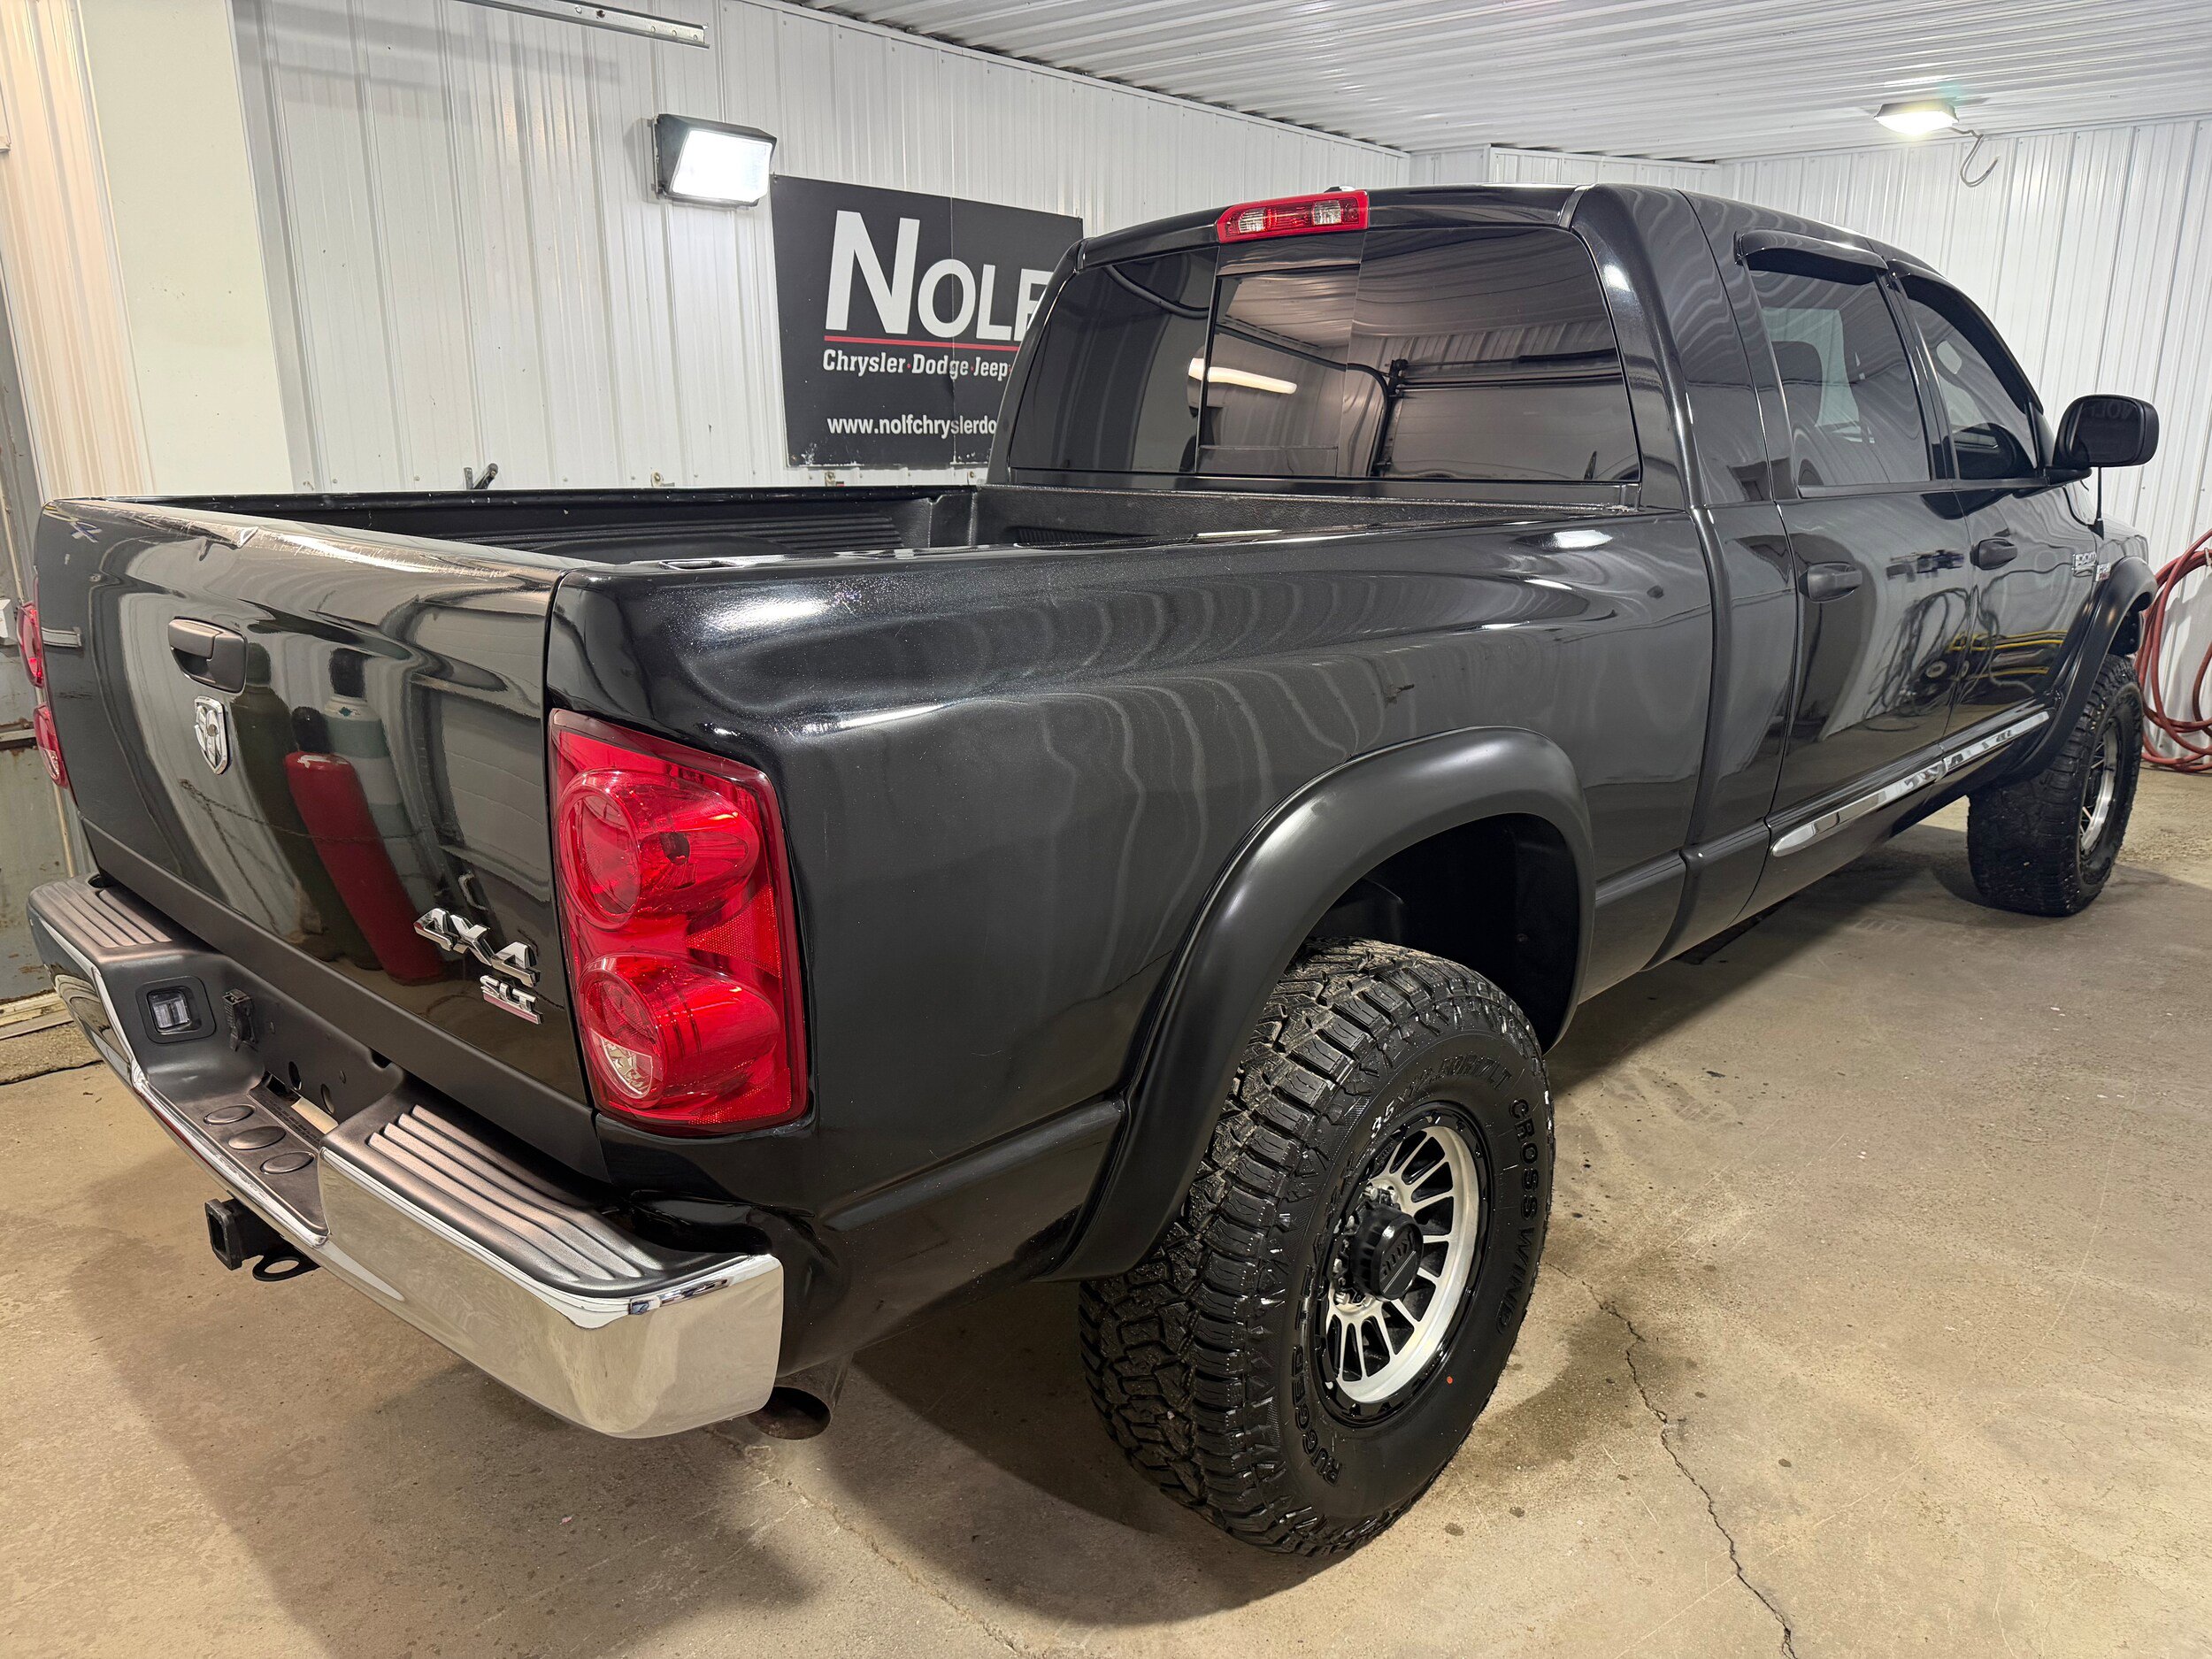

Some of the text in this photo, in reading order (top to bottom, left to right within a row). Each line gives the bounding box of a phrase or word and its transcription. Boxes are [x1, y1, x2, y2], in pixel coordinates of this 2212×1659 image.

[823, 349, 1008, 381] Chrysler Dodge Jeep
[480, 975, 537, 1013] SLT
[1292, 1344, 1342, 1486] RUGGED
